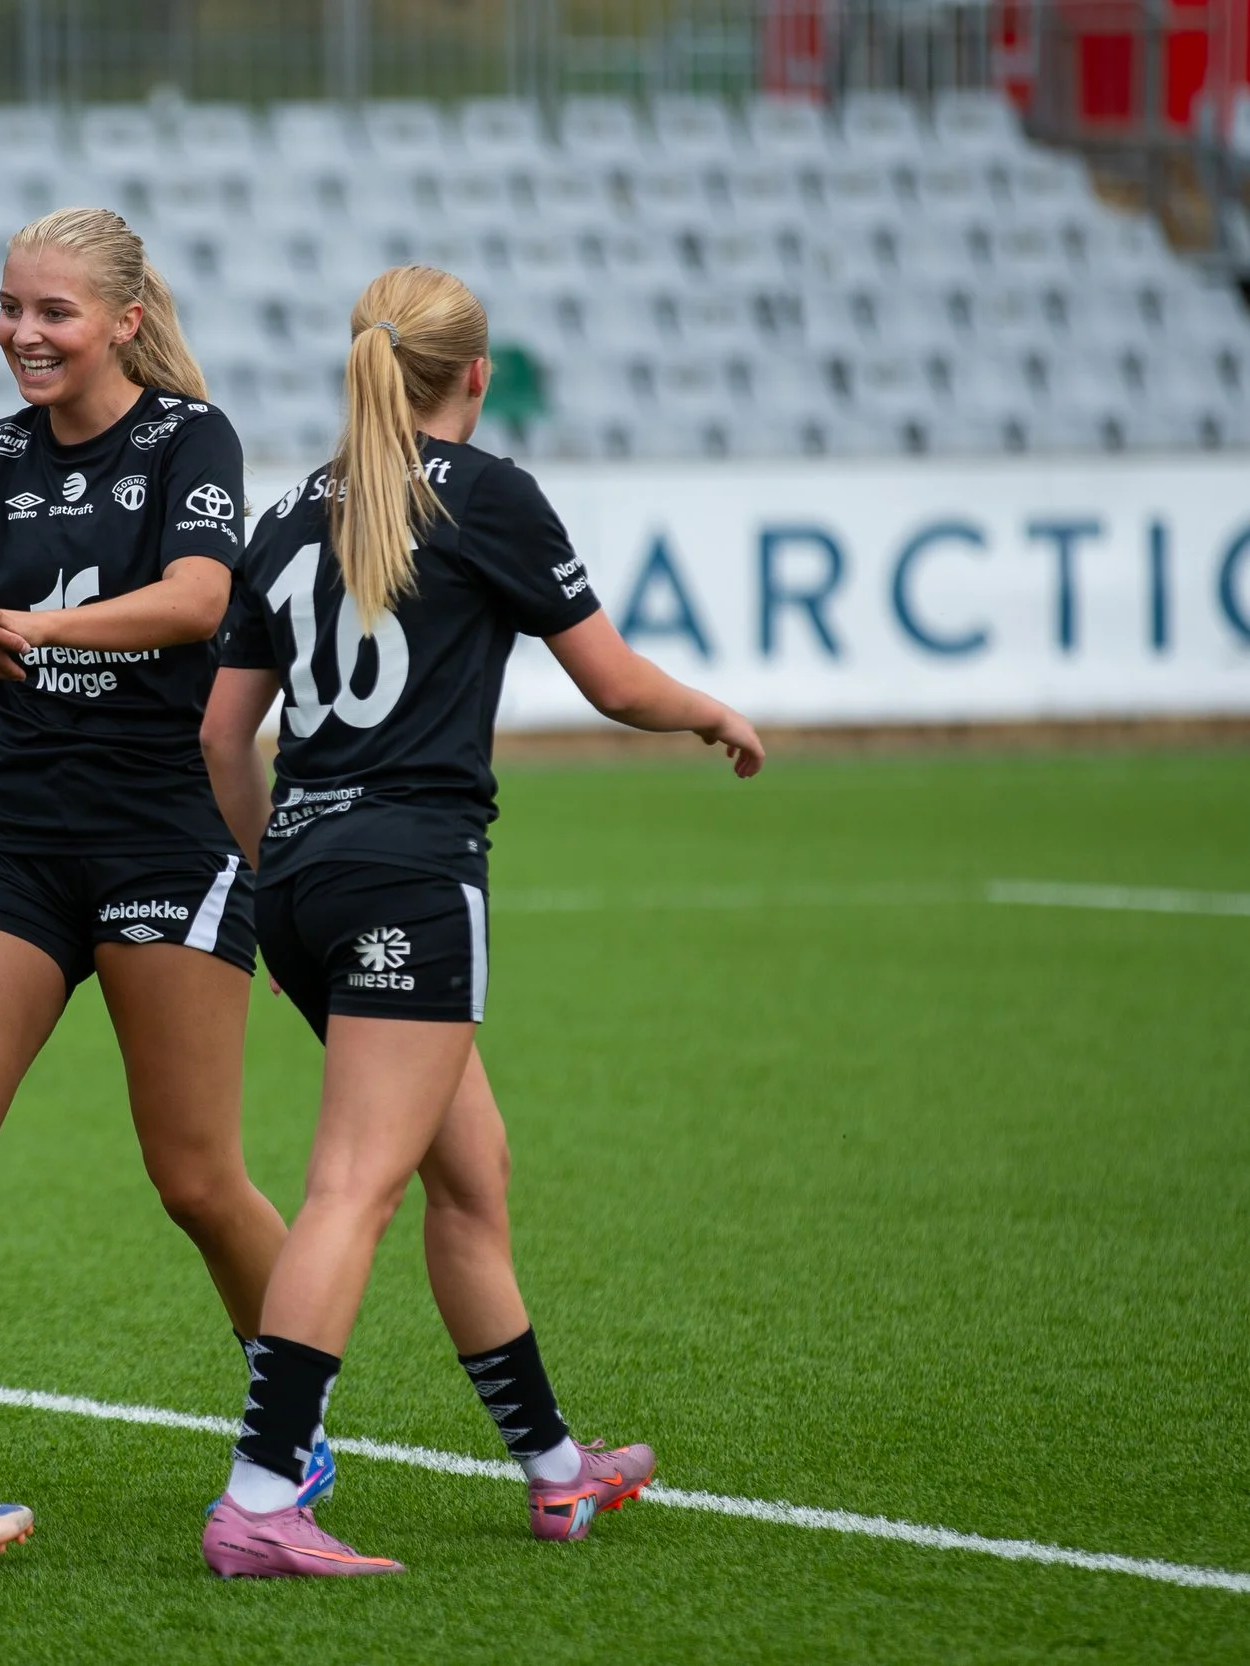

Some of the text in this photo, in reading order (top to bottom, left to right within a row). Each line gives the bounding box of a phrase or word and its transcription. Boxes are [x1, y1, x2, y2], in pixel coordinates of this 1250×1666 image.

[8, 509, 38, 521] umbro
[48, 503, 94, 517] Statkraft
[175, 519, 217, 531] Toyota
[266, 528, 419, 738] 16
[36, 667, 118, 698] Norge
[347, 971, 415, 991] mesta
